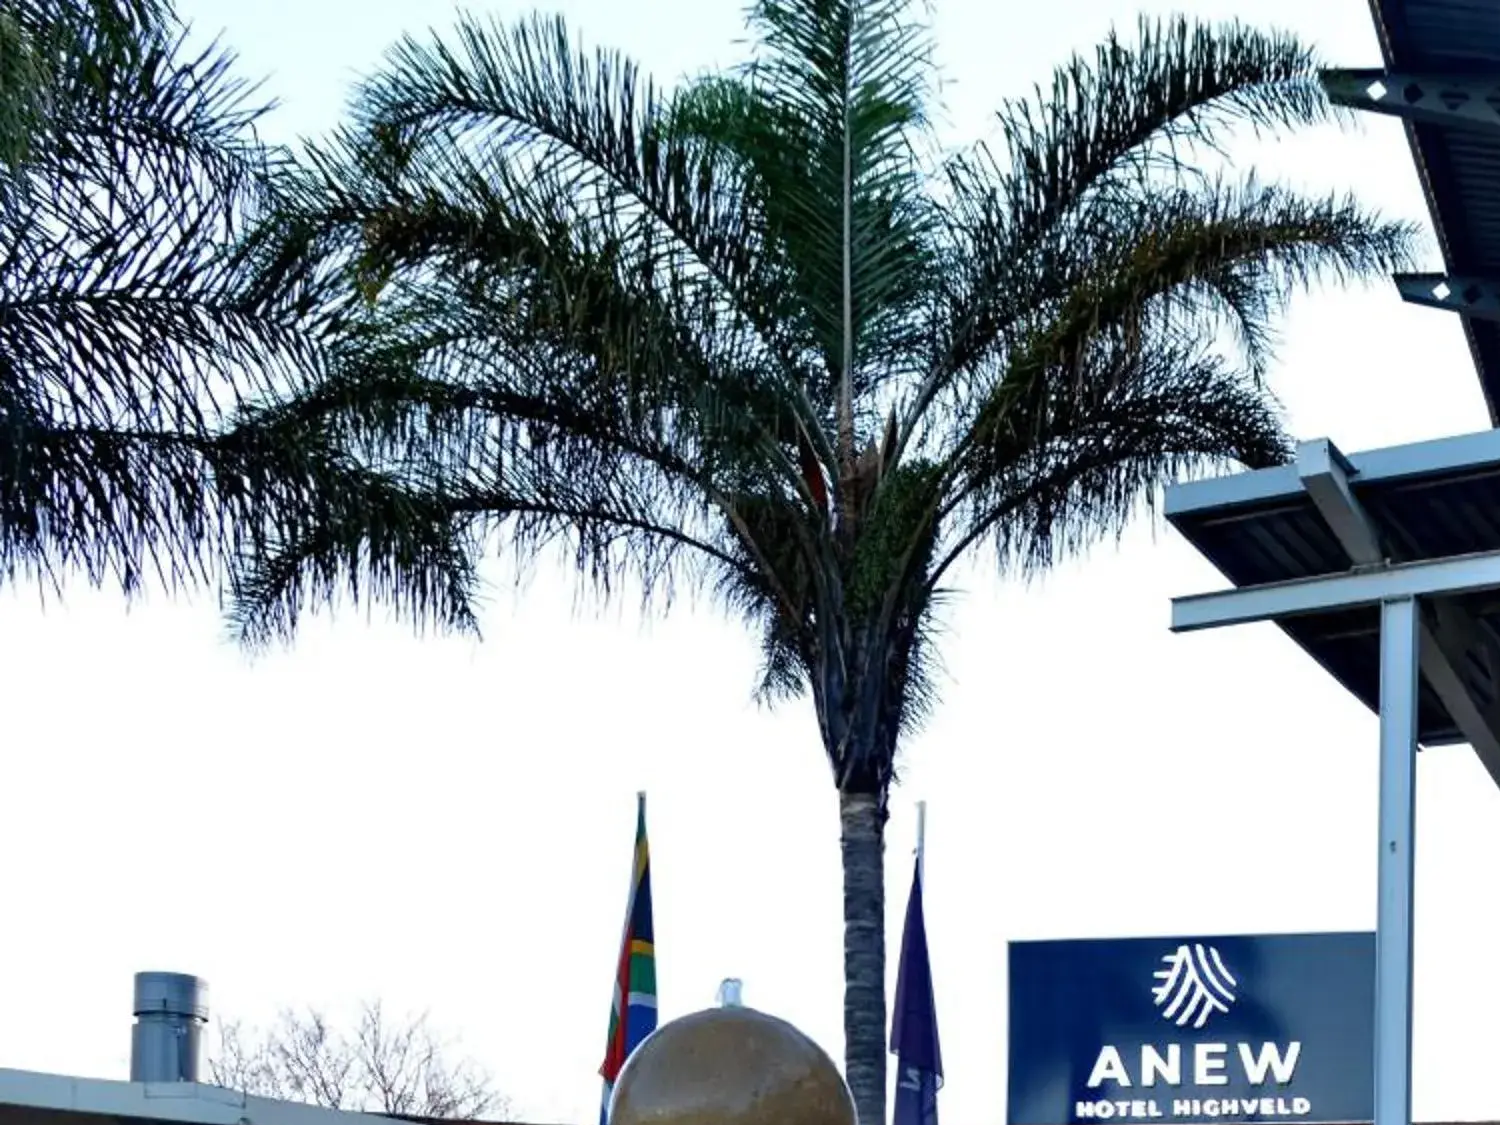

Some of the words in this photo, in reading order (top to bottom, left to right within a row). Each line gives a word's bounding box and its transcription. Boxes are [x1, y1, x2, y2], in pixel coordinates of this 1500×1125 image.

[1086, 1041, 1301, 1088] ANEW
[1075, 1099, 1163, 1118] HOTEL
[1172, 1097, 1311, 1117] HIGHVELD
